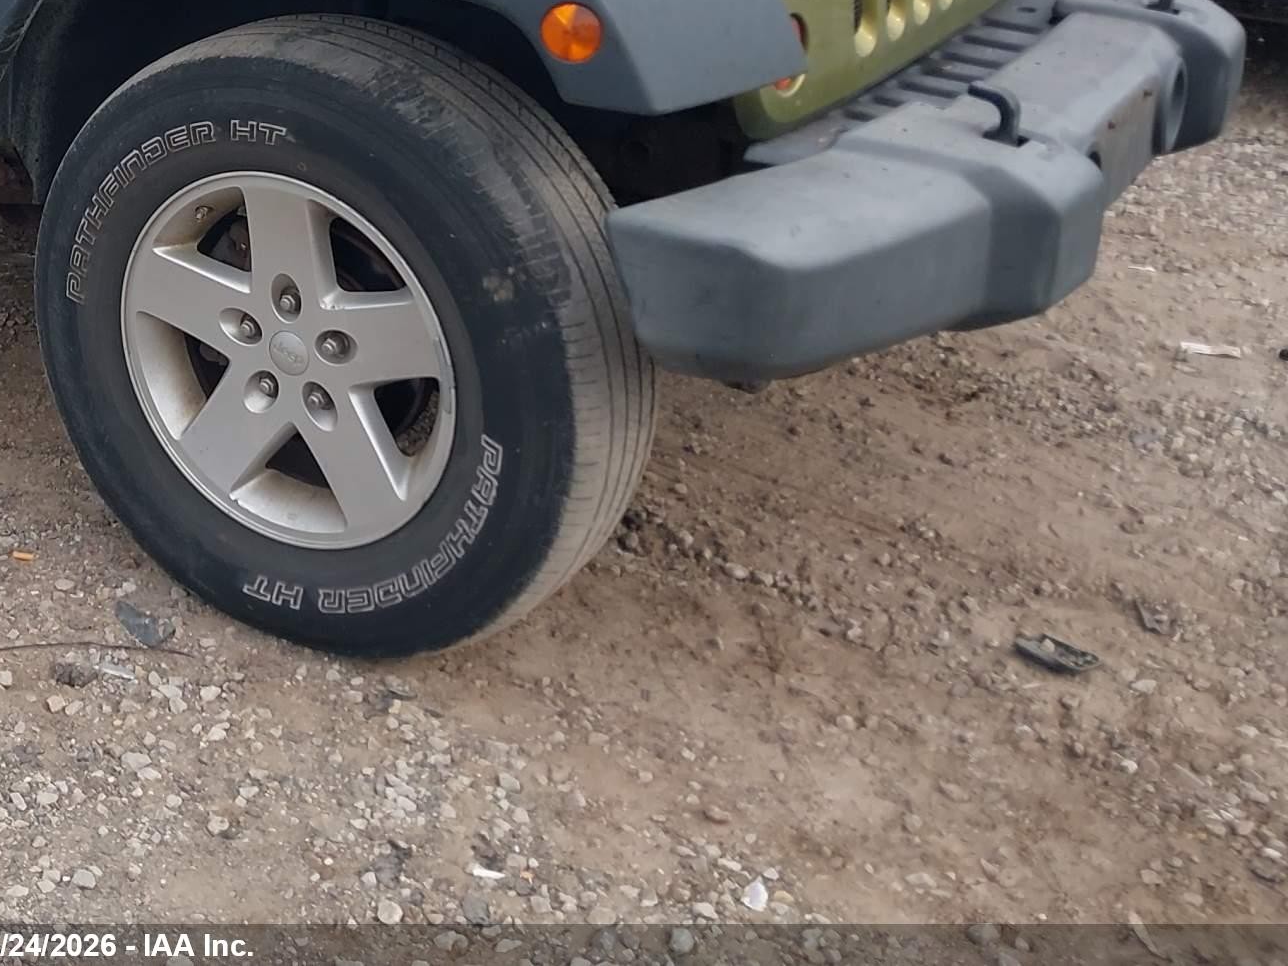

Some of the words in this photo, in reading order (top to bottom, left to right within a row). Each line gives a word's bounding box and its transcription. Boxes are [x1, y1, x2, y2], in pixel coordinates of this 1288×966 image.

[65, 120, 216, 305] PATHFINDER
[230, 119, 287, 145] HT
[242, 575, 303, 610] HT
[317, 434, 503, 614] PATHFINDER
